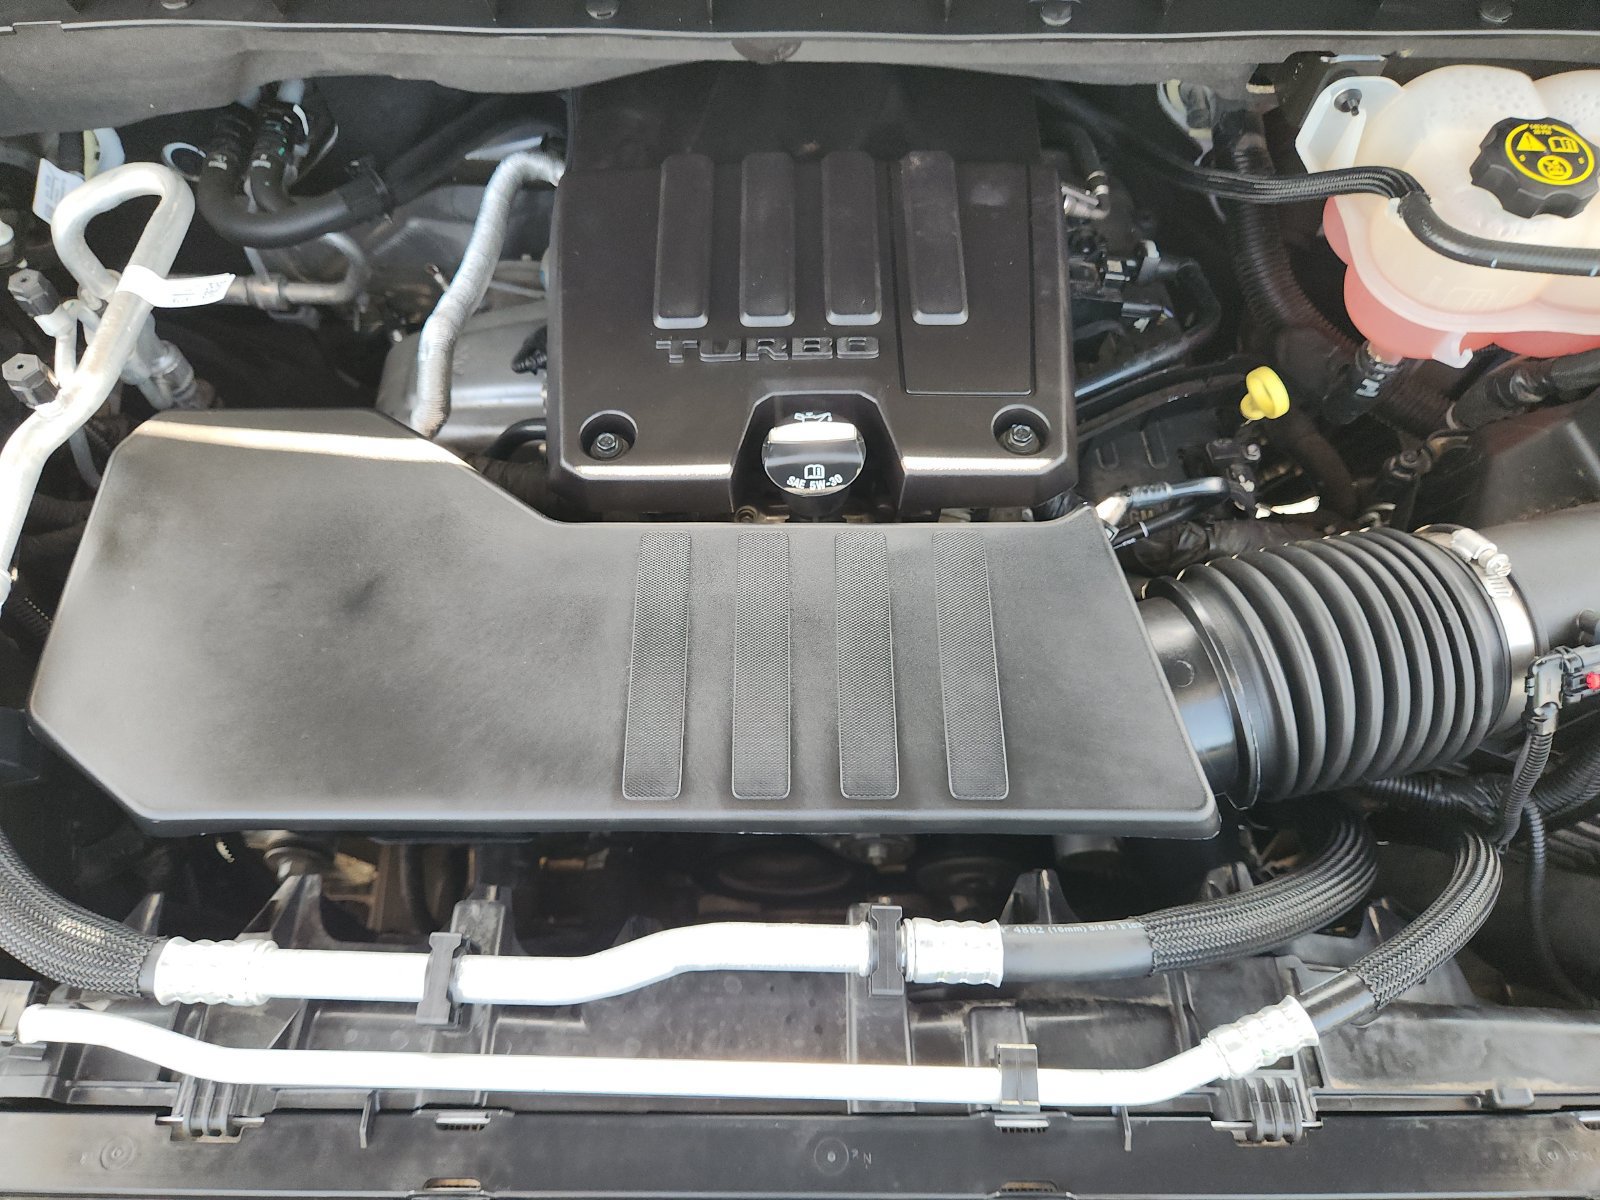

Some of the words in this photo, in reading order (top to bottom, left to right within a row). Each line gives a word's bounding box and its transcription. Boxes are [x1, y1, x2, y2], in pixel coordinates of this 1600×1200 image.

[656, 337, 879, 363] TURBO
[787, 475, 806, 490] SAE
[809, 474, 843, 491] 5W-30
[1013, 926, 1045, 935] 4882
